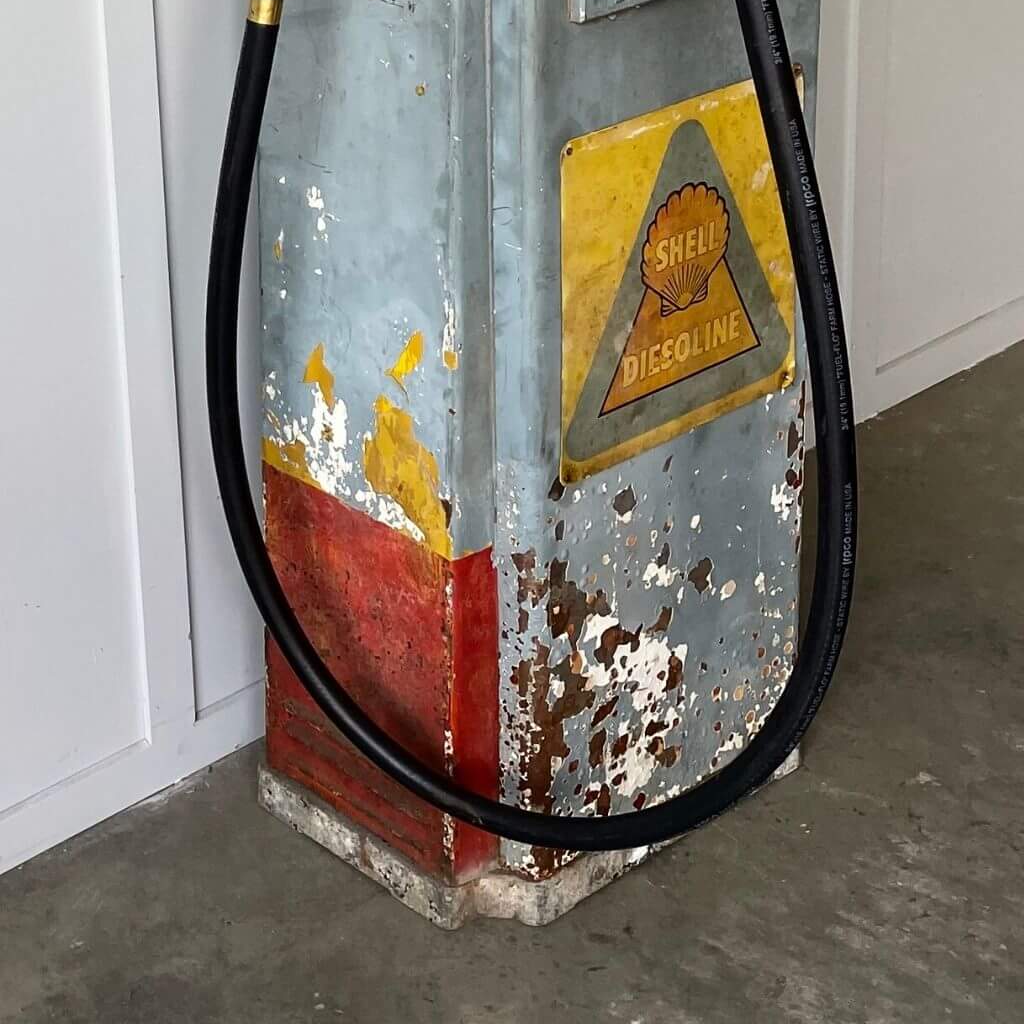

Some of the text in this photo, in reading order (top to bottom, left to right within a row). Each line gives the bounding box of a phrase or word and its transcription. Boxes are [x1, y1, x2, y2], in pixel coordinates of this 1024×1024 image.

[789, 118, 799, 137] USA
[797, 148, 806, 173] MADE
[812, 221, 821, 244] WIRE
[655, 221, 721, 273] SHELL
[817, 245, 827, 274] STATIC
[824, 282, 833, 305] HOSE
[621, 308, 742, 388] DIESOLINE
